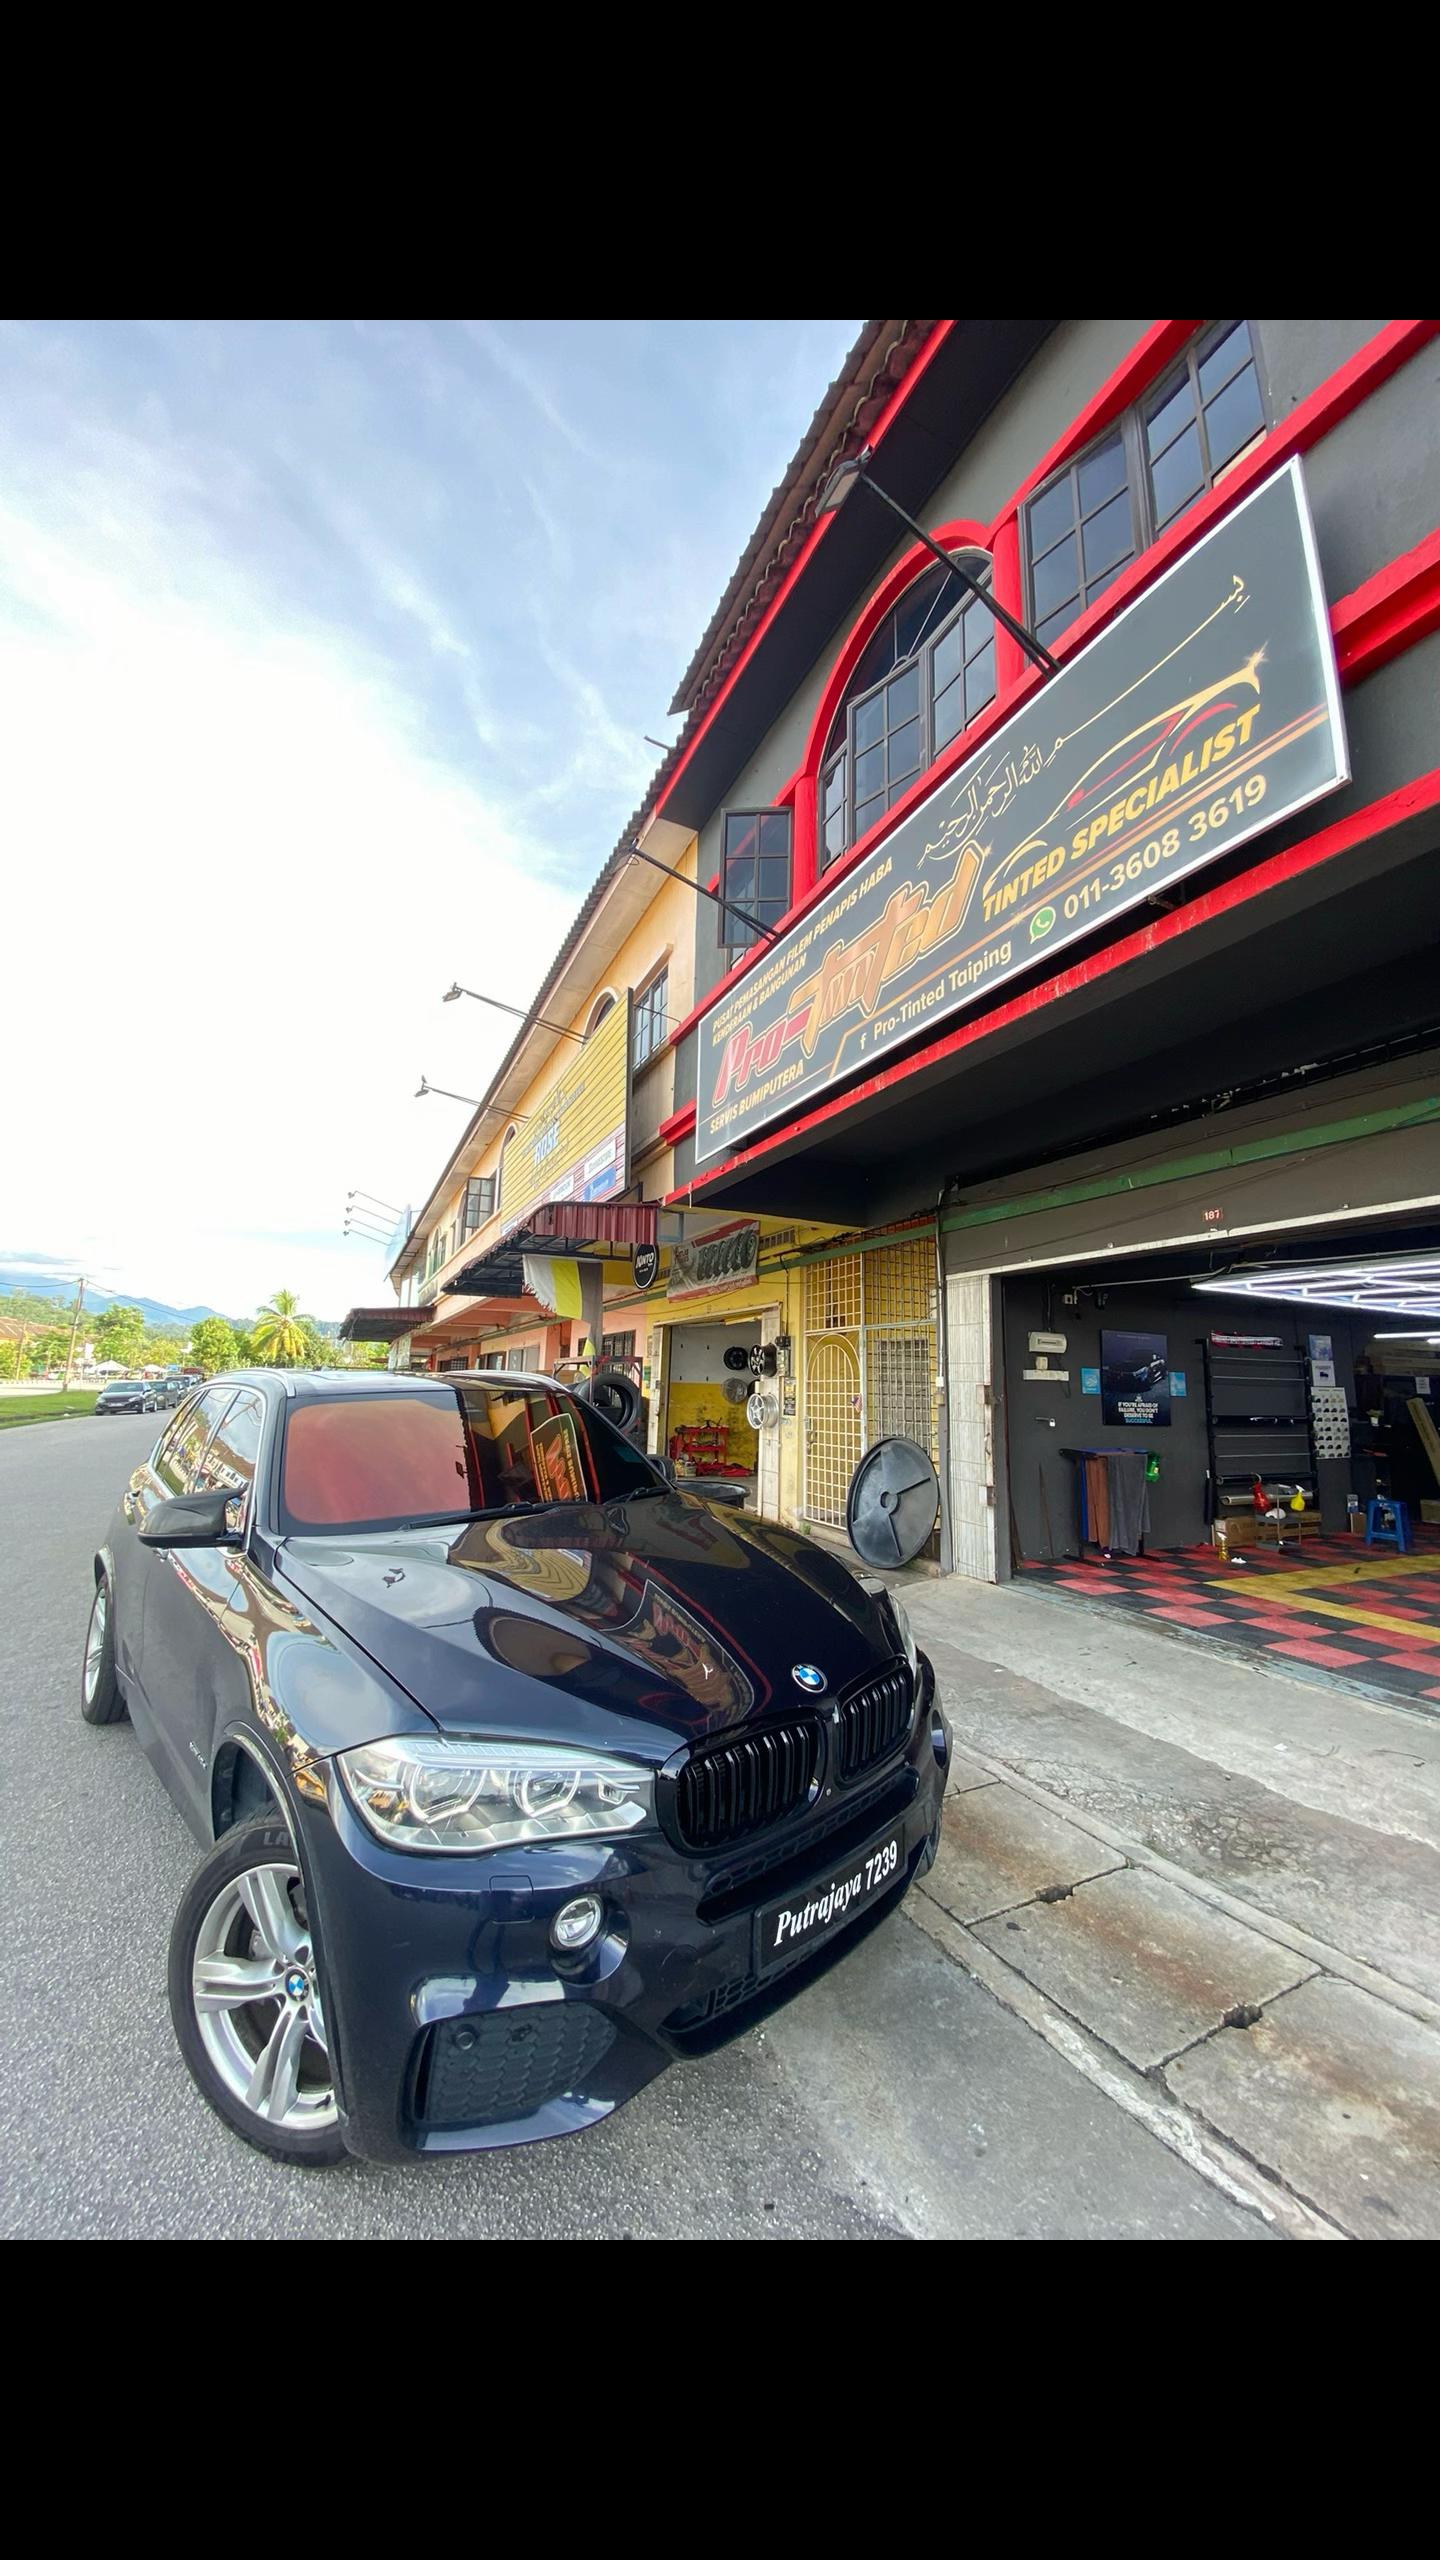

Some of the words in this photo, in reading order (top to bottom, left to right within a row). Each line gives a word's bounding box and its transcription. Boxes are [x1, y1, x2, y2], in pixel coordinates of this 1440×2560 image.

[983, 847, 1066, 923] TINTED
[1070, 704, 1261, 859] SPECIALIST
[1064, 828, 1180, 919] 011-3608
[1188, 774, 1266, 843] 3619
[786, 930, 813, 965] FILEM
[813, 889, 858, 940] PENAPIS
[859, 856, 892, 899] HABA
[874, 979, 945, 1040] Pro-Tinted
[949, 940, 1012, 991] Taiping
[710, 1104, 738, 1134] SERVIS
[739, 1059, 804, 1116] BUMIPUTERA
[1204, 1209, 1220, 1221] 187
[773, 1872, 862, 1946] Putrajaya
[865, 1840, 897, 1890] 7239
